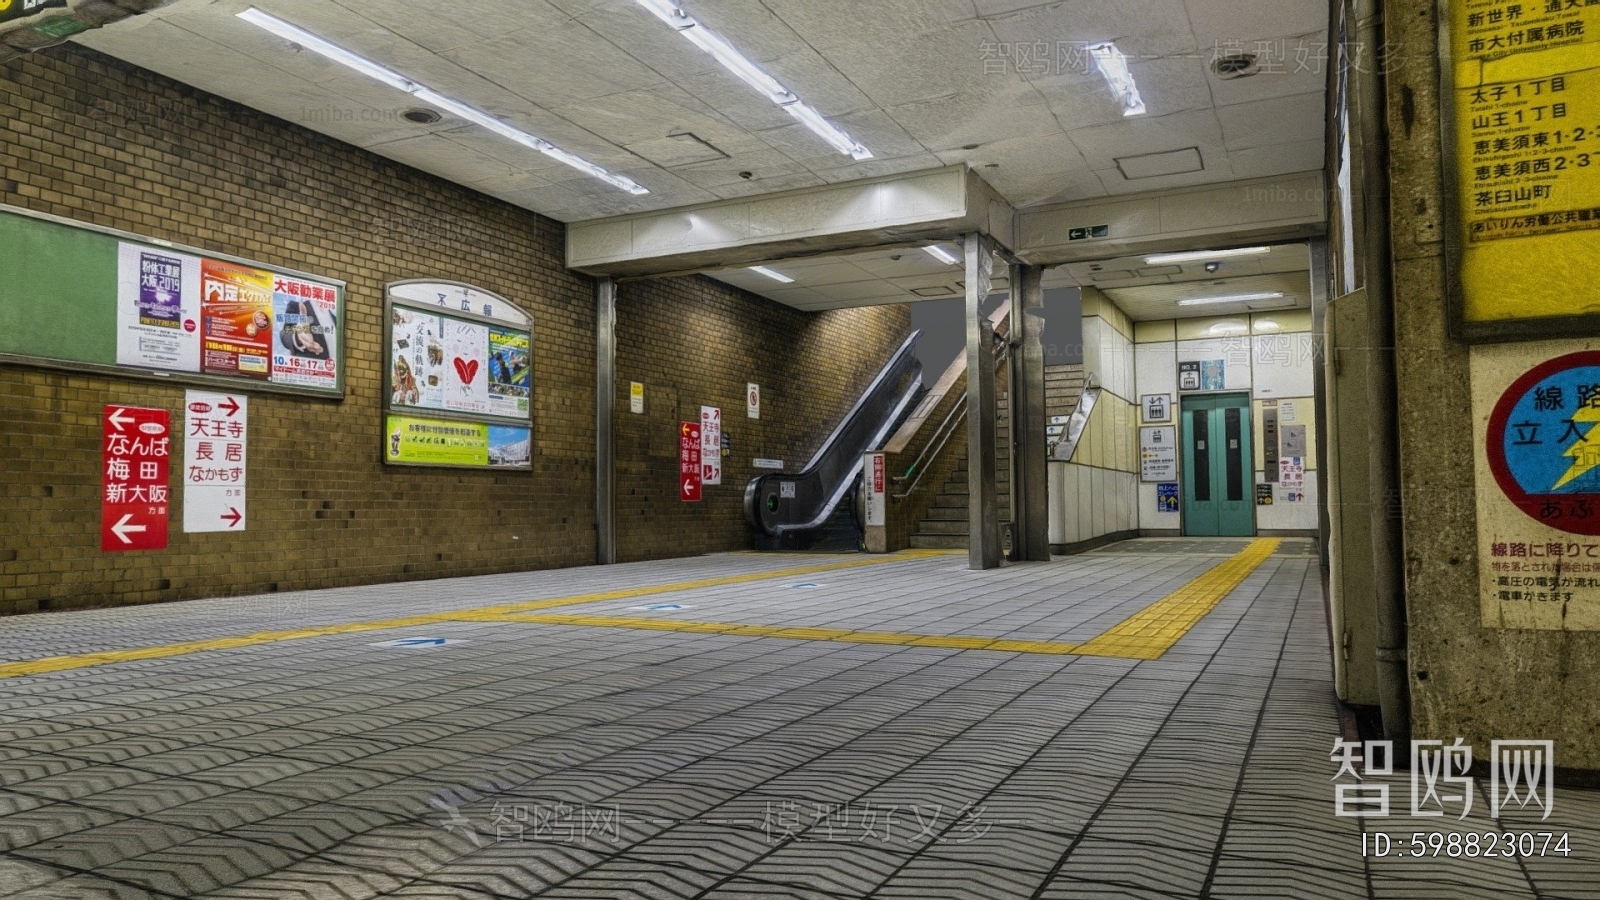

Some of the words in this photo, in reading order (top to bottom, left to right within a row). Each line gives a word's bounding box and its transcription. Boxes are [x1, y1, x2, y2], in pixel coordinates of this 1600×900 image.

[1468, 20, 1584, 52] 市大付属病院
[1470, 76, 1565, 104] 太子1丁目
[1472, 102, 1567, 130] 山王1丁目
[1474, 125, 1600, 155] 恵美須東1・2・
[1474, 151, 1600, 180] 恵美須西2・3
[1475, 184, 1552, 206] 茶臼山町
[190, 417, 244, 439] 天王寺
[106, 432, 170, 456] なんば
[106, 457, 158, 481] 梅田
[188, 464, 243, 482] なかもず
[106, 481, 168, 504] 新大阪
[1491, 542, 1599, 558] 線路に降りて
